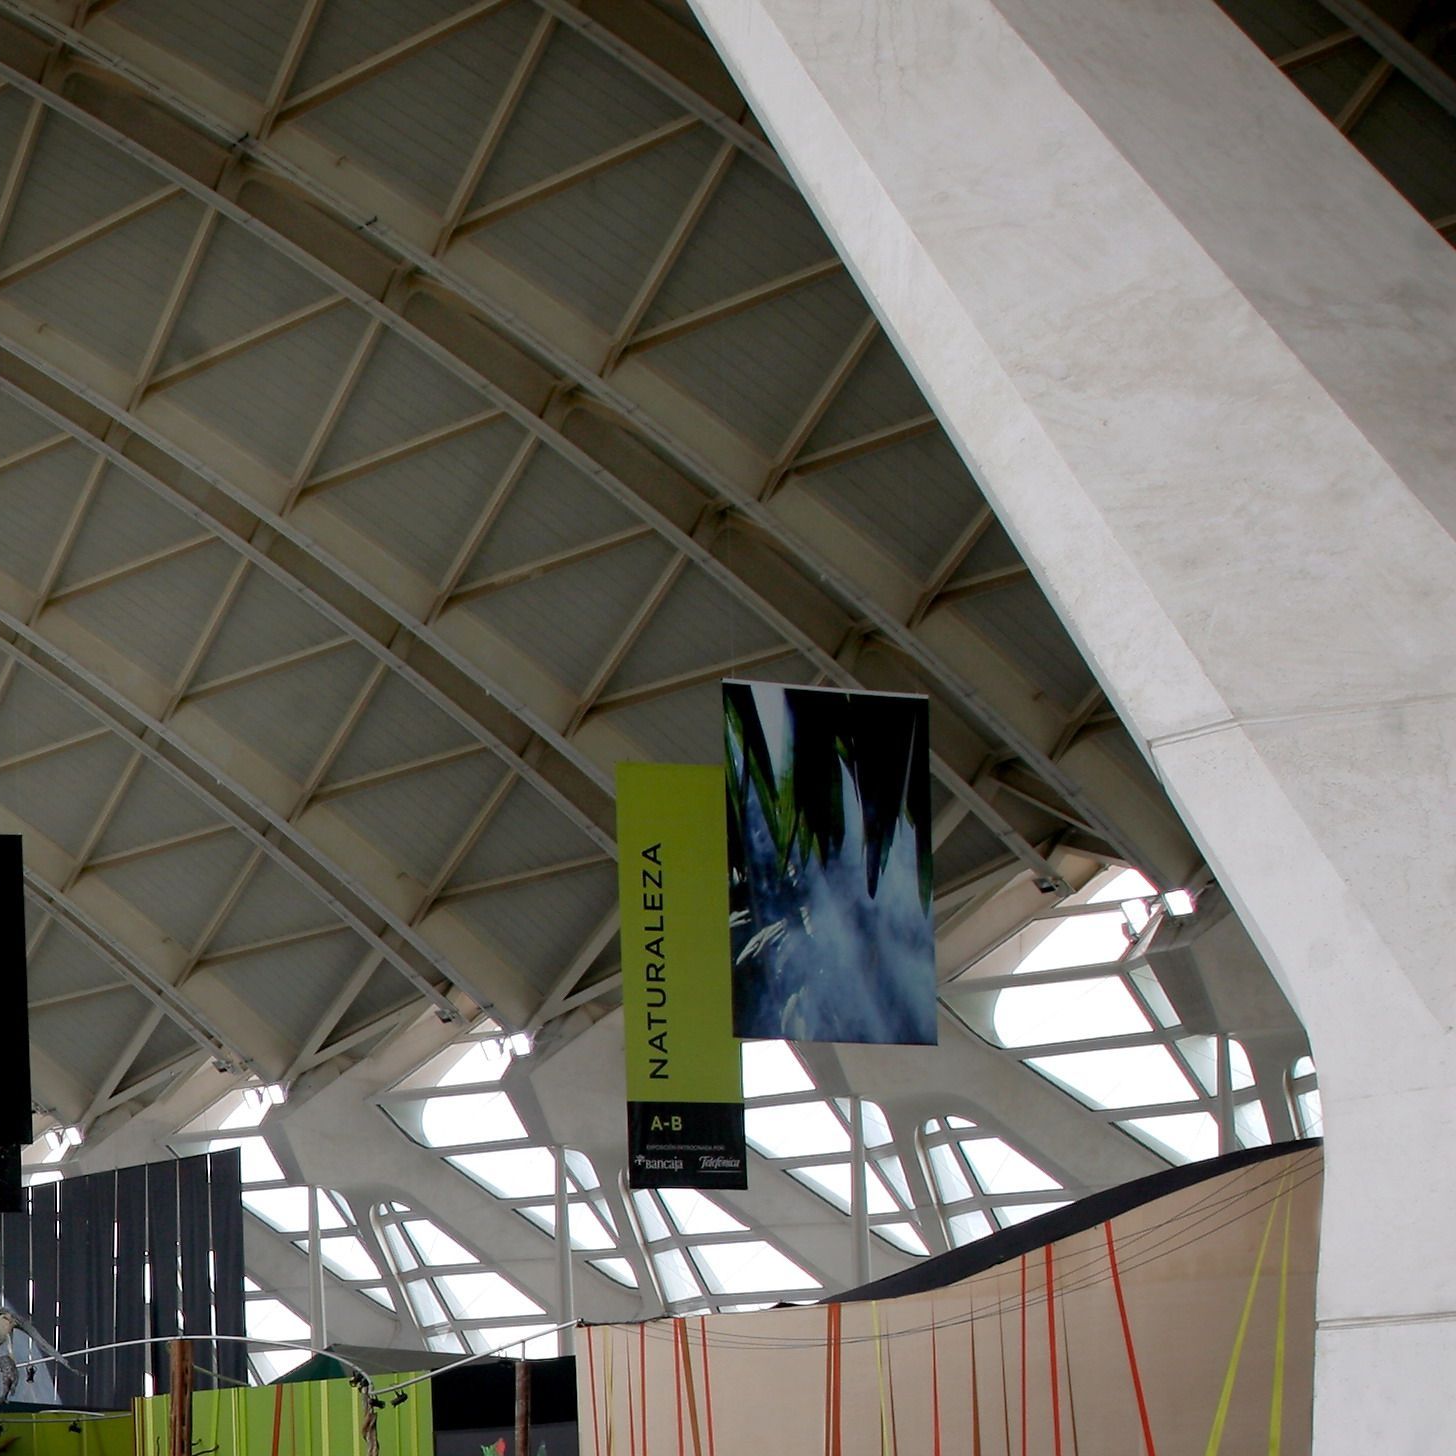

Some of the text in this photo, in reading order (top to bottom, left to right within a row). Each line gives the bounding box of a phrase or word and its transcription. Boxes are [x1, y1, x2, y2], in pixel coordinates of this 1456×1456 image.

[641, 841, 669, 1080] NATURALEZA
[651, 1115, 683, 1131] A-B
[698, 1155, 741, 1170] Telefónica
